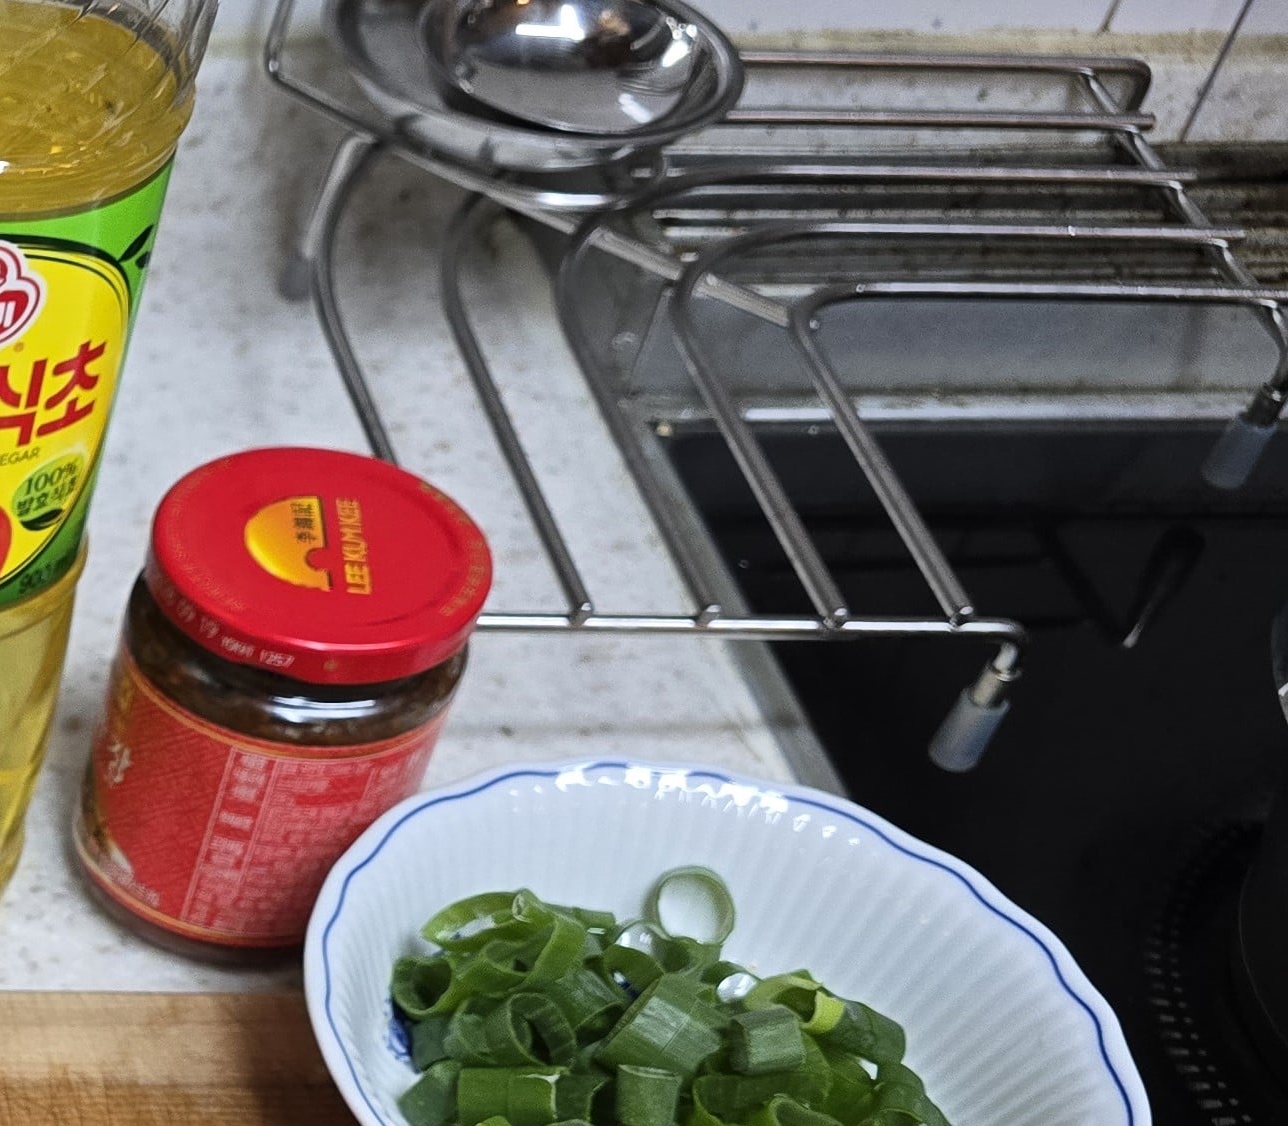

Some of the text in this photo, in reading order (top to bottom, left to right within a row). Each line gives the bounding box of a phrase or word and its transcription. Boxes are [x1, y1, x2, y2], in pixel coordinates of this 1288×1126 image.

[24, 461, 78, 495] 100%
[335, 497, 373, 595] LEE KUM KEE
